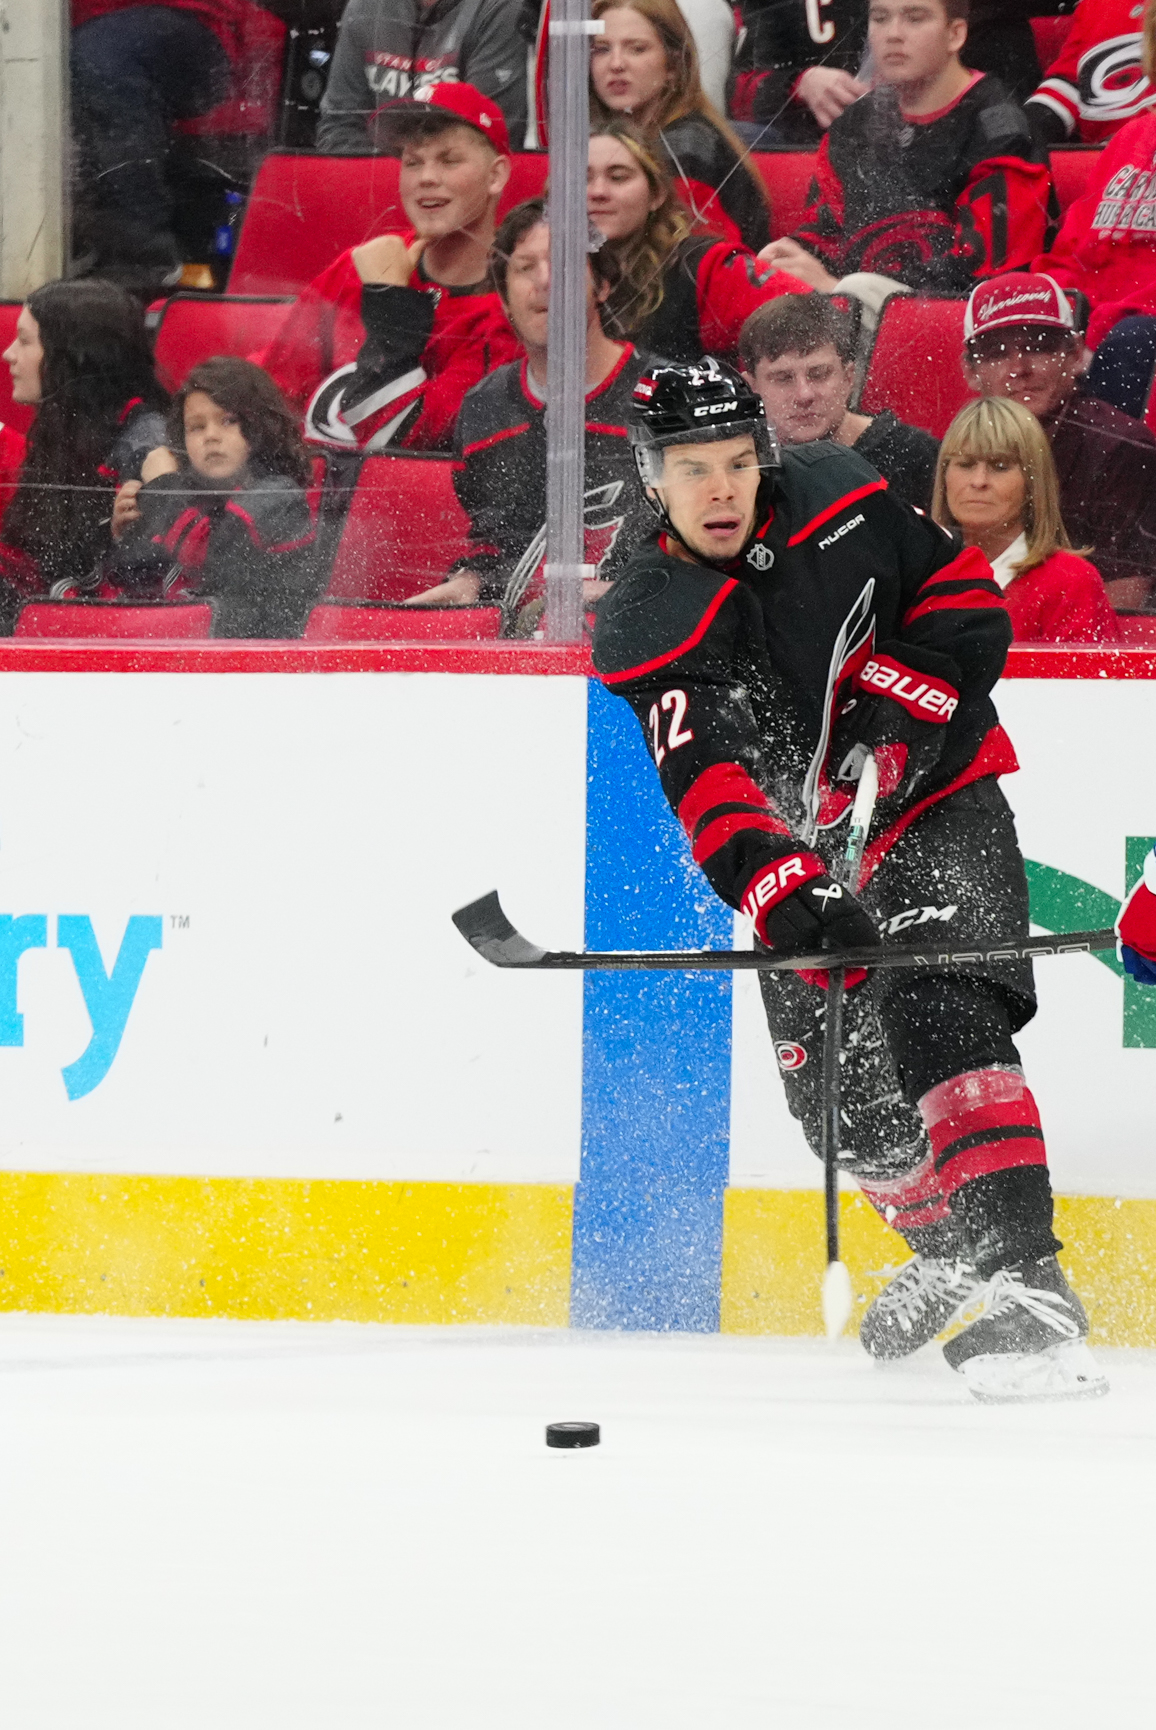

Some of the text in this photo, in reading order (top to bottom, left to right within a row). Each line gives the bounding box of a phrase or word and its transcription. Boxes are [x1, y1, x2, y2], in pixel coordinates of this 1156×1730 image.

[694, 401, 738, 417] CCM
[818, 514, 865, 550] NUCOR
[860, 661, 959, 721] BAUER
[649, 689, 694, 768] 22
[0, 914, 163, 1101] ry
